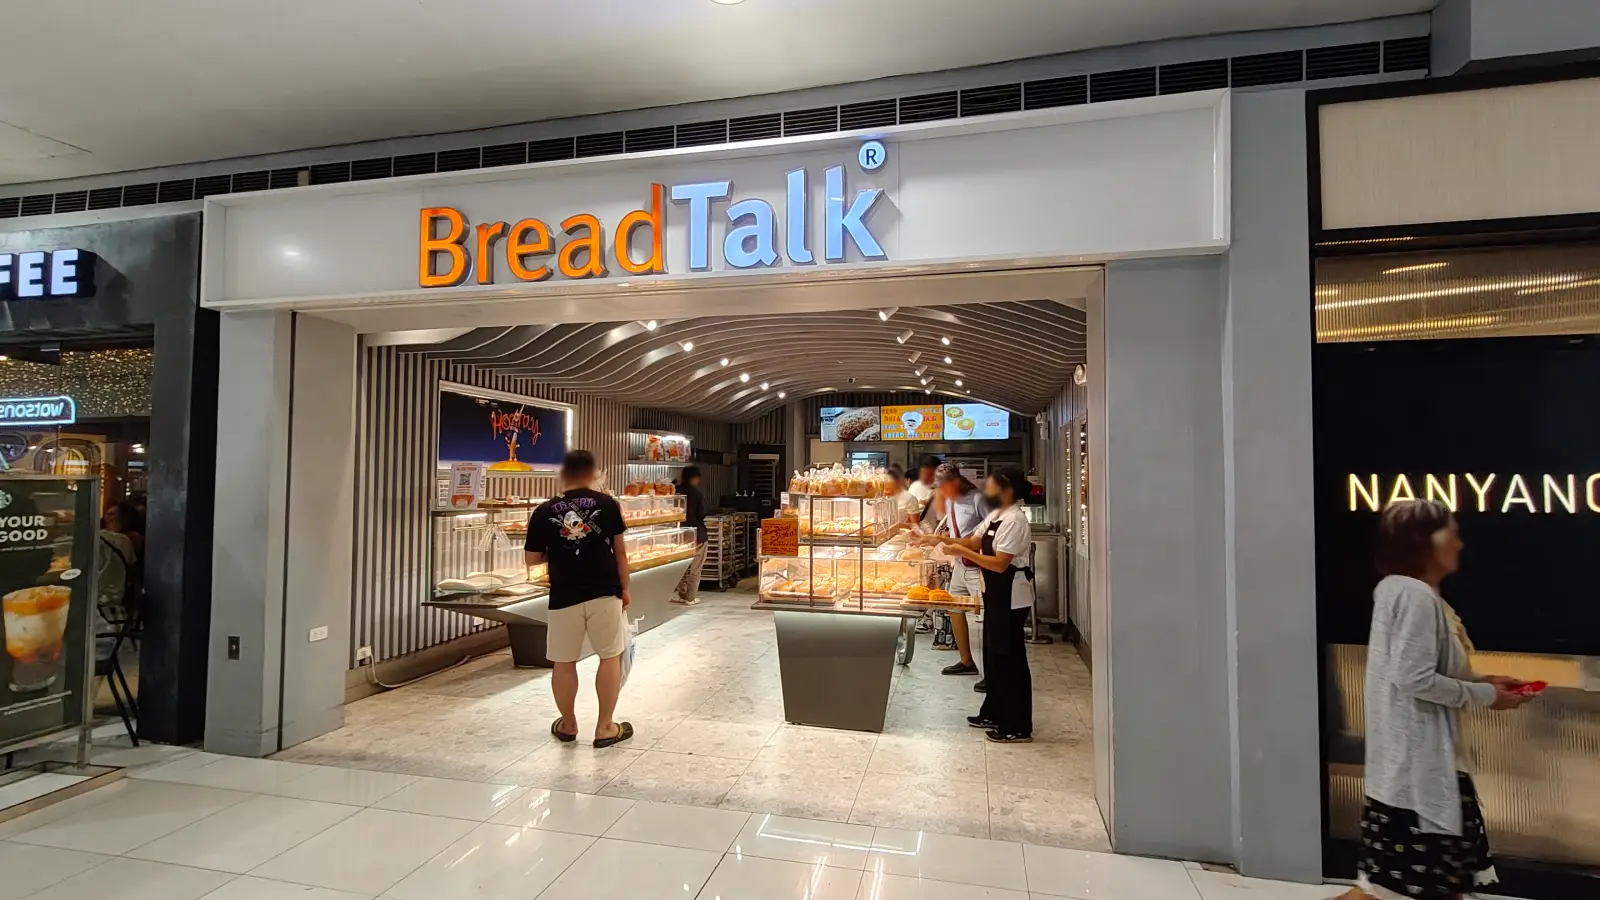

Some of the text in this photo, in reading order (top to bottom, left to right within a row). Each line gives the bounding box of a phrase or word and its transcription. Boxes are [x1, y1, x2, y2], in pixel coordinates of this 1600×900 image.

[419, 164, 886, 287] BreadTalk
[0, 515, 45, 528] YOUR
[0, 529, 48, 542] GOOD
